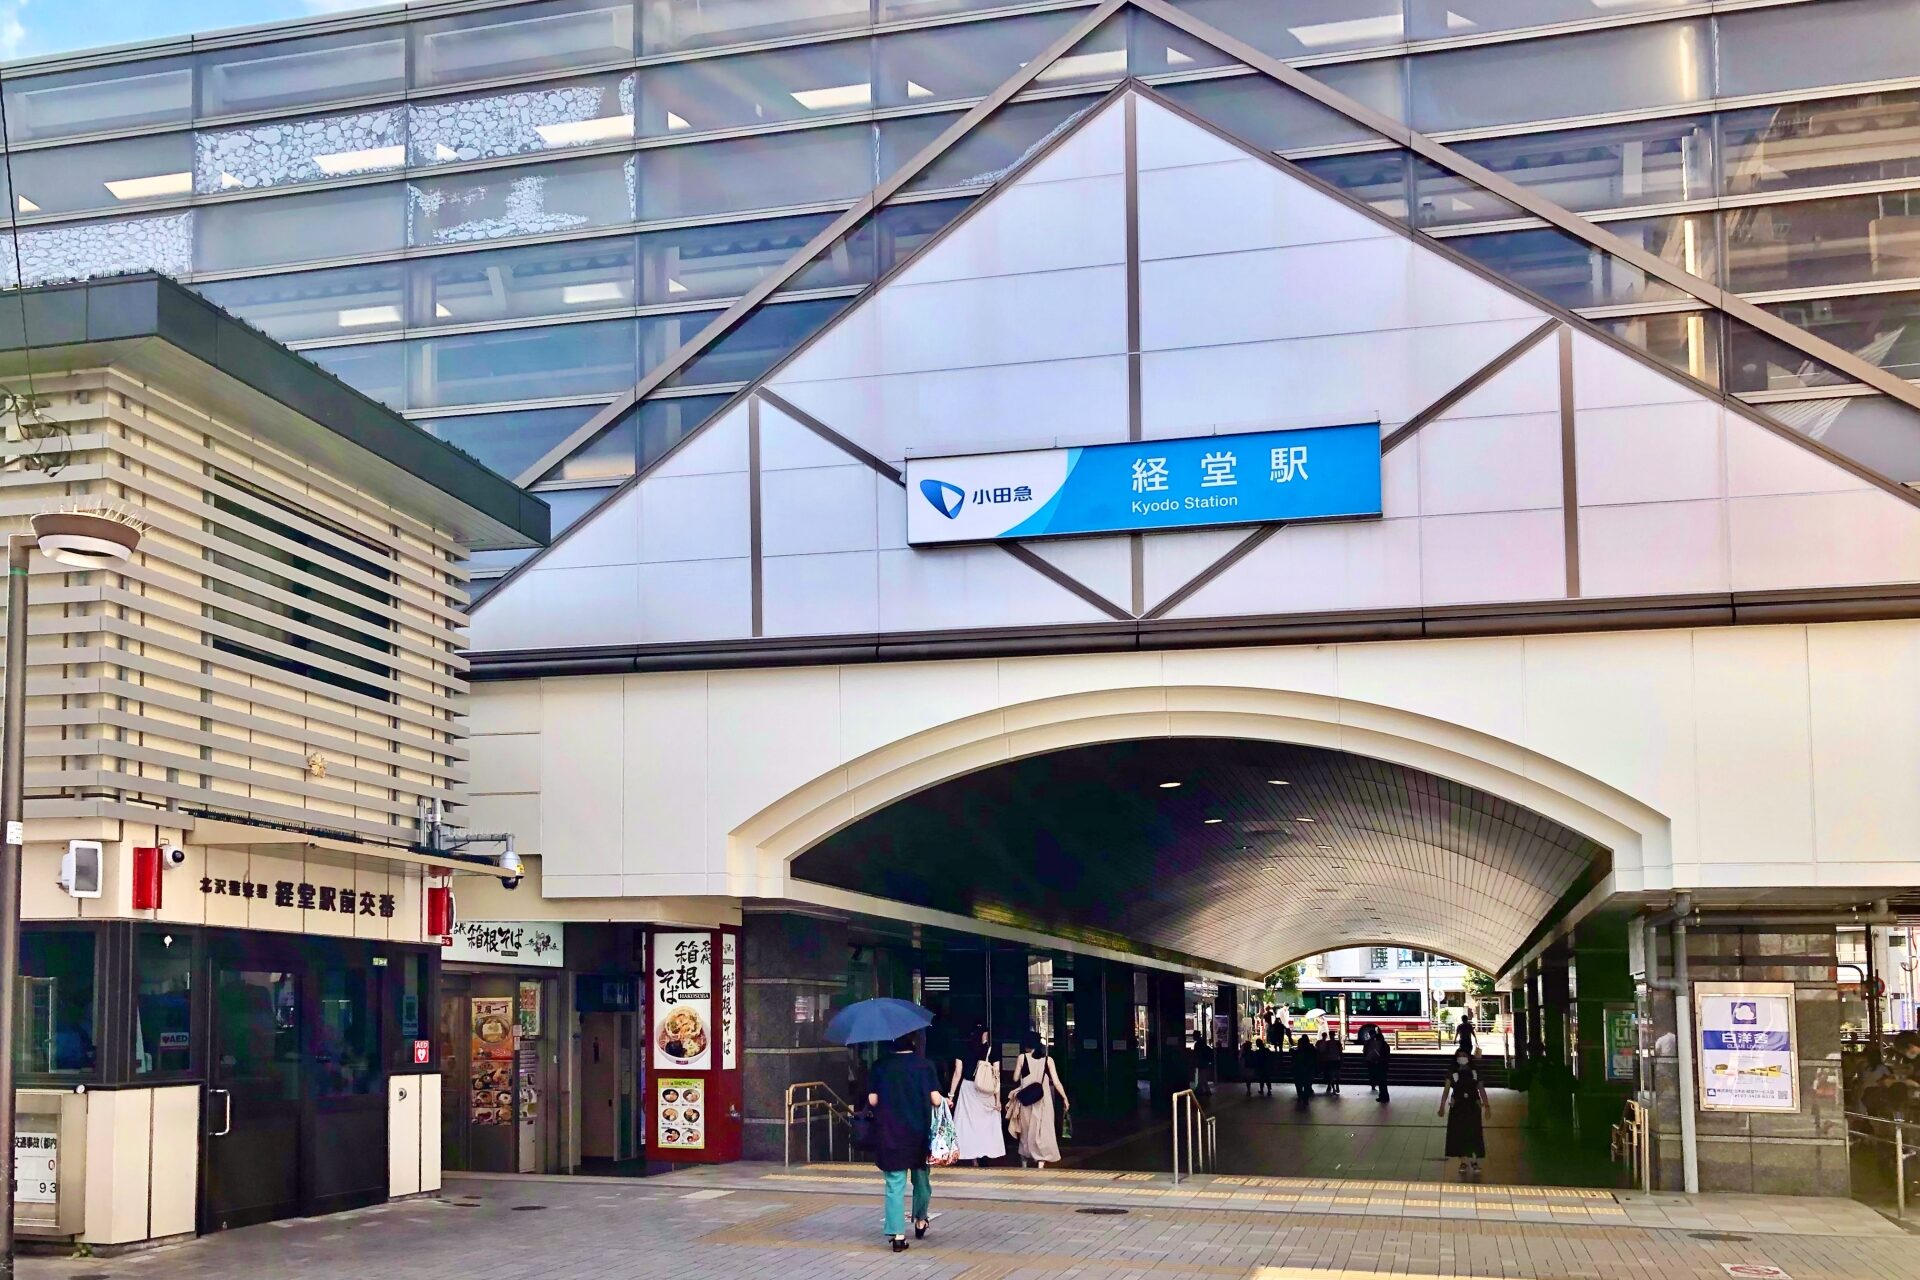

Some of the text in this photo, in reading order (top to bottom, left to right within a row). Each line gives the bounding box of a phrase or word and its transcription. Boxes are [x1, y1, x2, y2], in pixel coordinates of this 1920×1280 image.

[1131, 446, 1309, 494] 経堂駅
[972, 485, 1033, 505] 小田急
[1132, 495, 1238, 516] Kyodo Station
[199, 877, 396, 918] 北沢警察署 経堂駅前交番
[467, 924, 524, 953] 箱根そば
[674, 940, 704, 990] 箱根
[656, 967, 680, 1005] そば
[477, 1004, 509, 1014] 豆腐一丁
